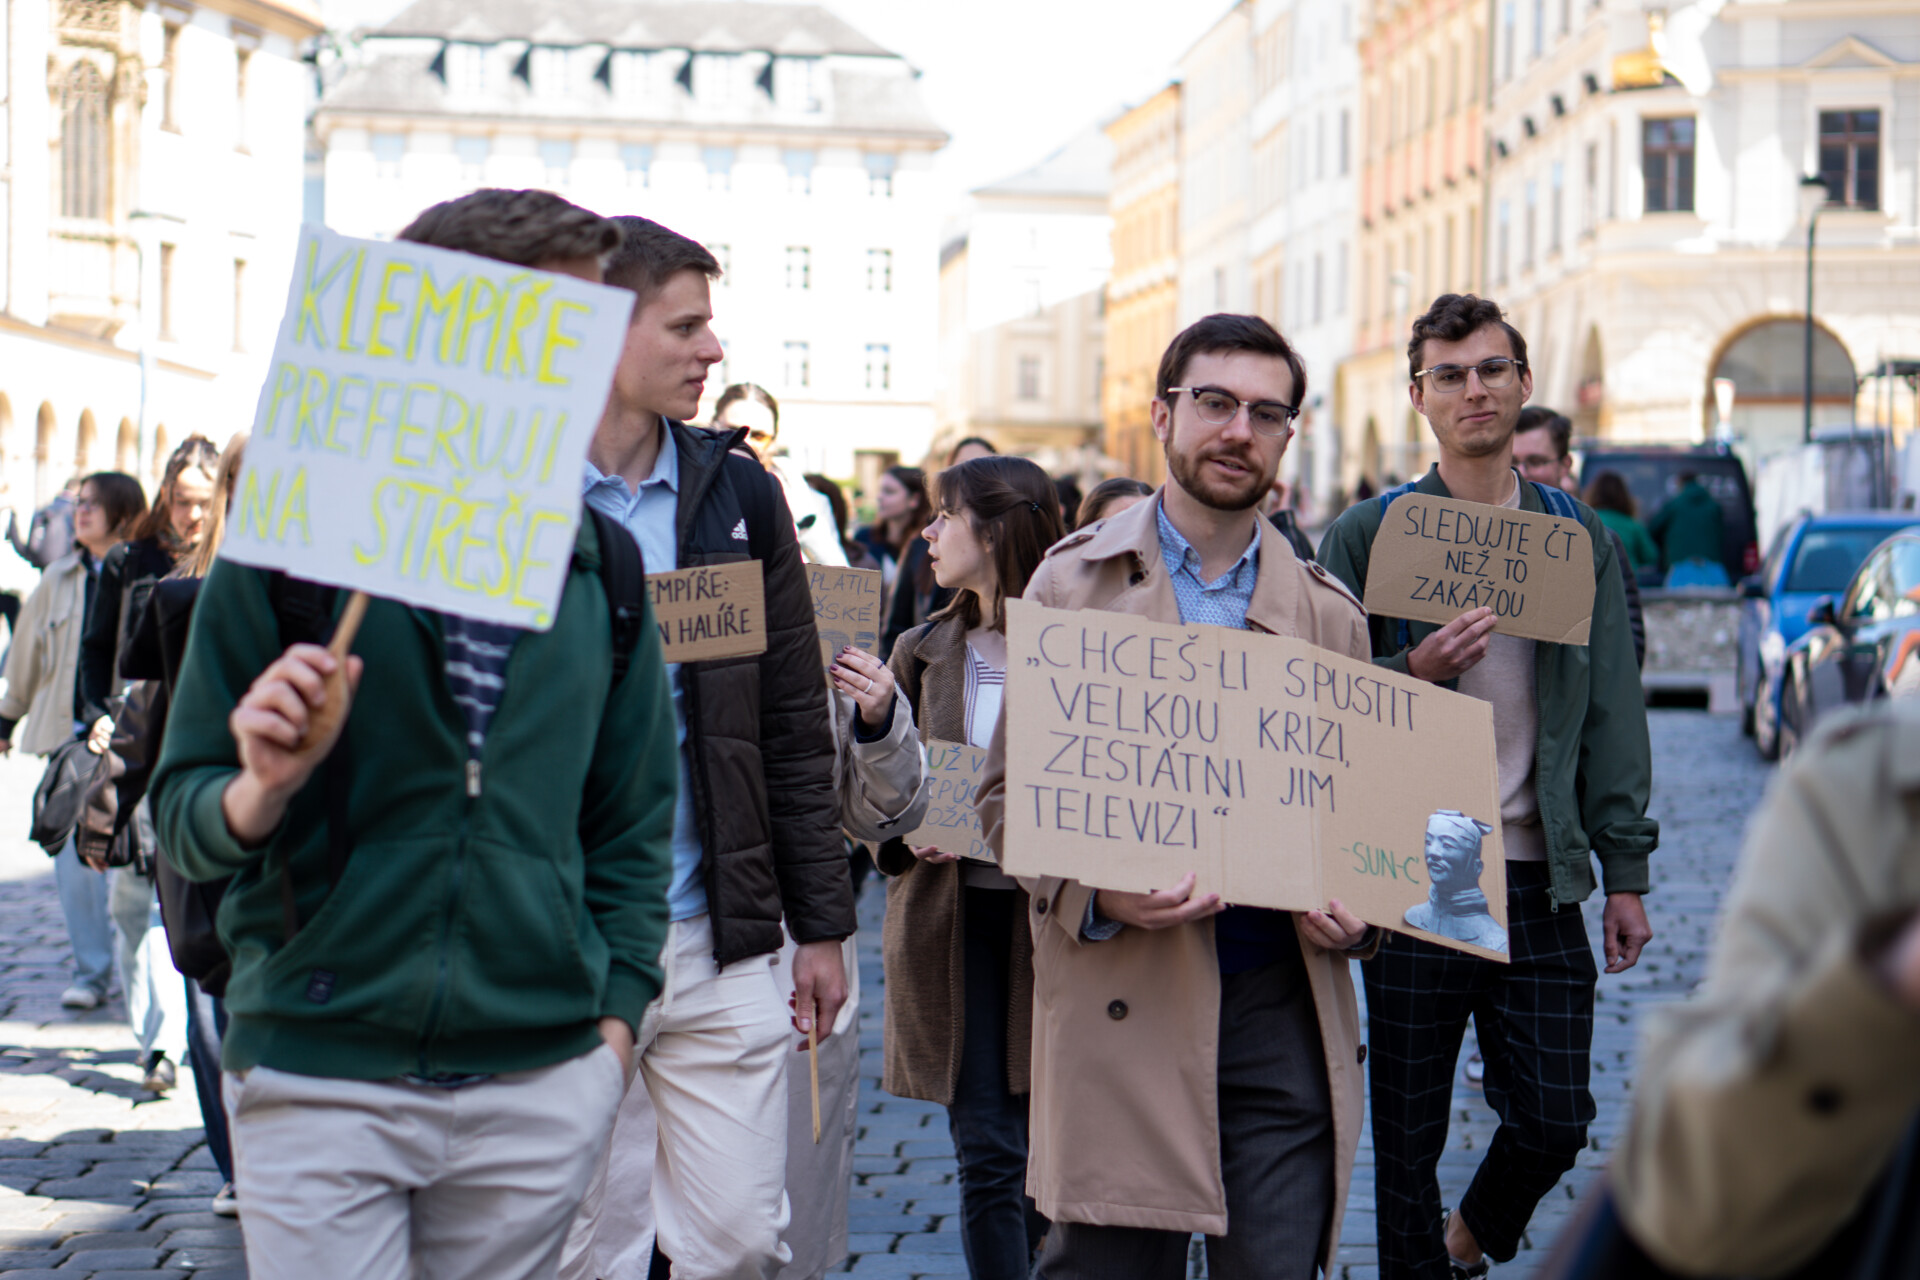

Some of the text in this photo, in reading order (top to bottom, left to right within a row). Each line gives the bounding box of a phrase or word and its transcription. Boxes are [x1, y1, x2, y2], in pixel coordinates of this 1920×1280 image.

[293, 239, 595, 386] KLEMPÍŘE
[263, 361, 569, 484] PREFERUJI
[237, 466, 312, 546] NA
[1403, 505, 1578, 562] SLEDUJTE ČT
[1409, 575, 1525, 618] ZAKÁŽOU
[1444, 550, 1528, 584] NEŽ TO
[679, 602, 753, 644] HALÍŘE
[1050, 676, 1350, 768] VELKOU KRIZI,
[1284, 657, 1420, 732] SPUSTIT
[1044, 730, 1335, 813] ZESTÁTNI JIM
